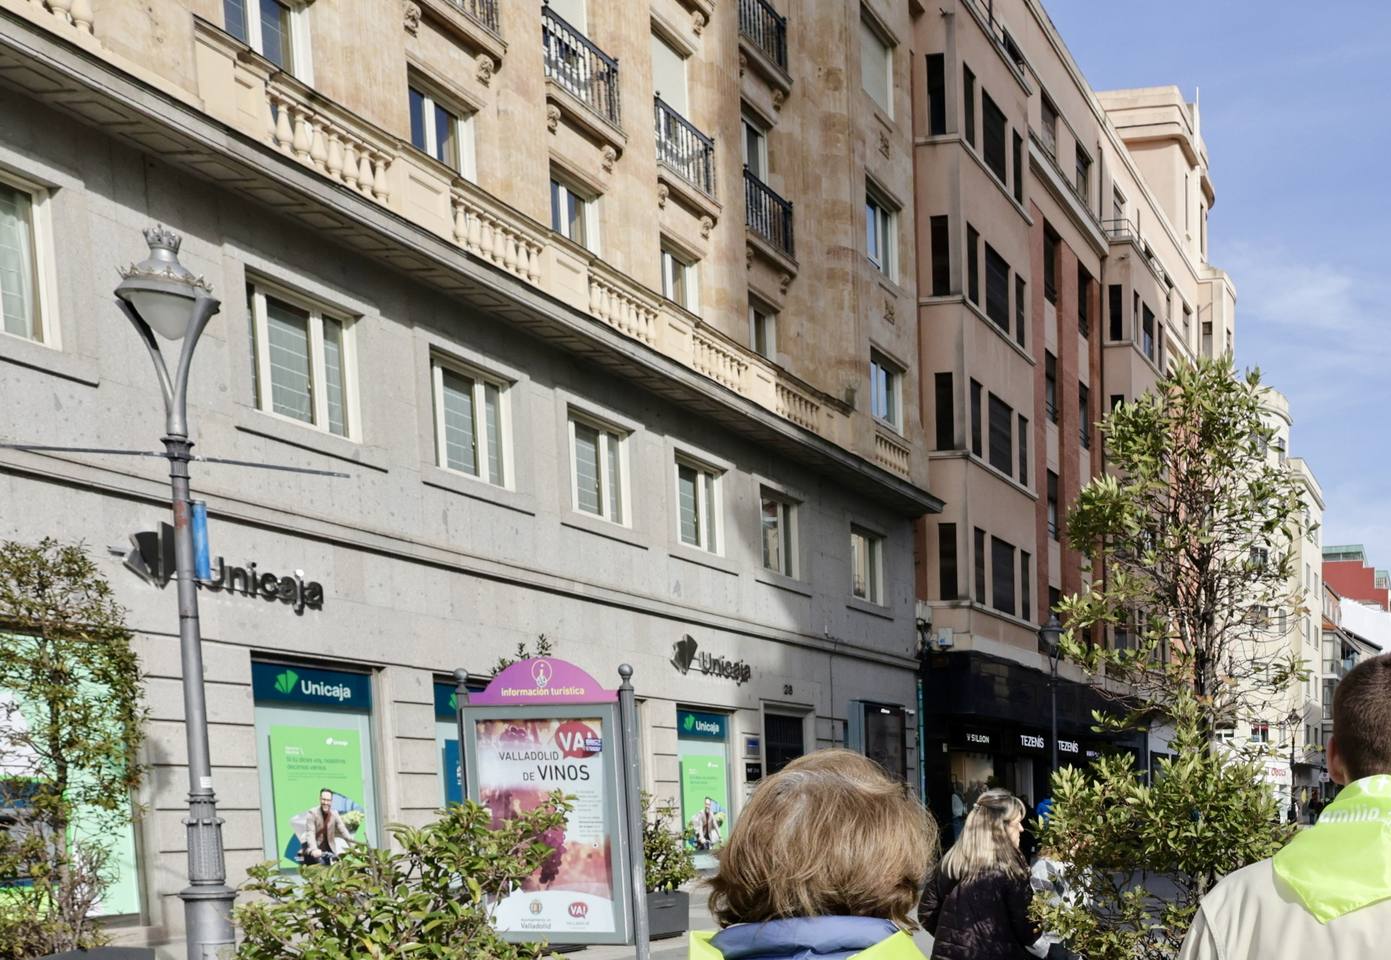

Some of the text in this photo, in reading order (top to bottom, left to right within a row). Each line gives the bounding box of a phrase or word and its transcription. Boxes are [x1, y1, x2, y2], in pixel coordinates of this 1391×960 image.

[701, 651, 751, 687] Unicaja
[301, 679, 352, 702] Unicaja
[695, 720, 720, 735] Unicaja
[498, 751, 559, 761] VALLADOLID
[522, 764, 590, 781] DE VINOS
[520, 922, 552, 930] Valladolid
